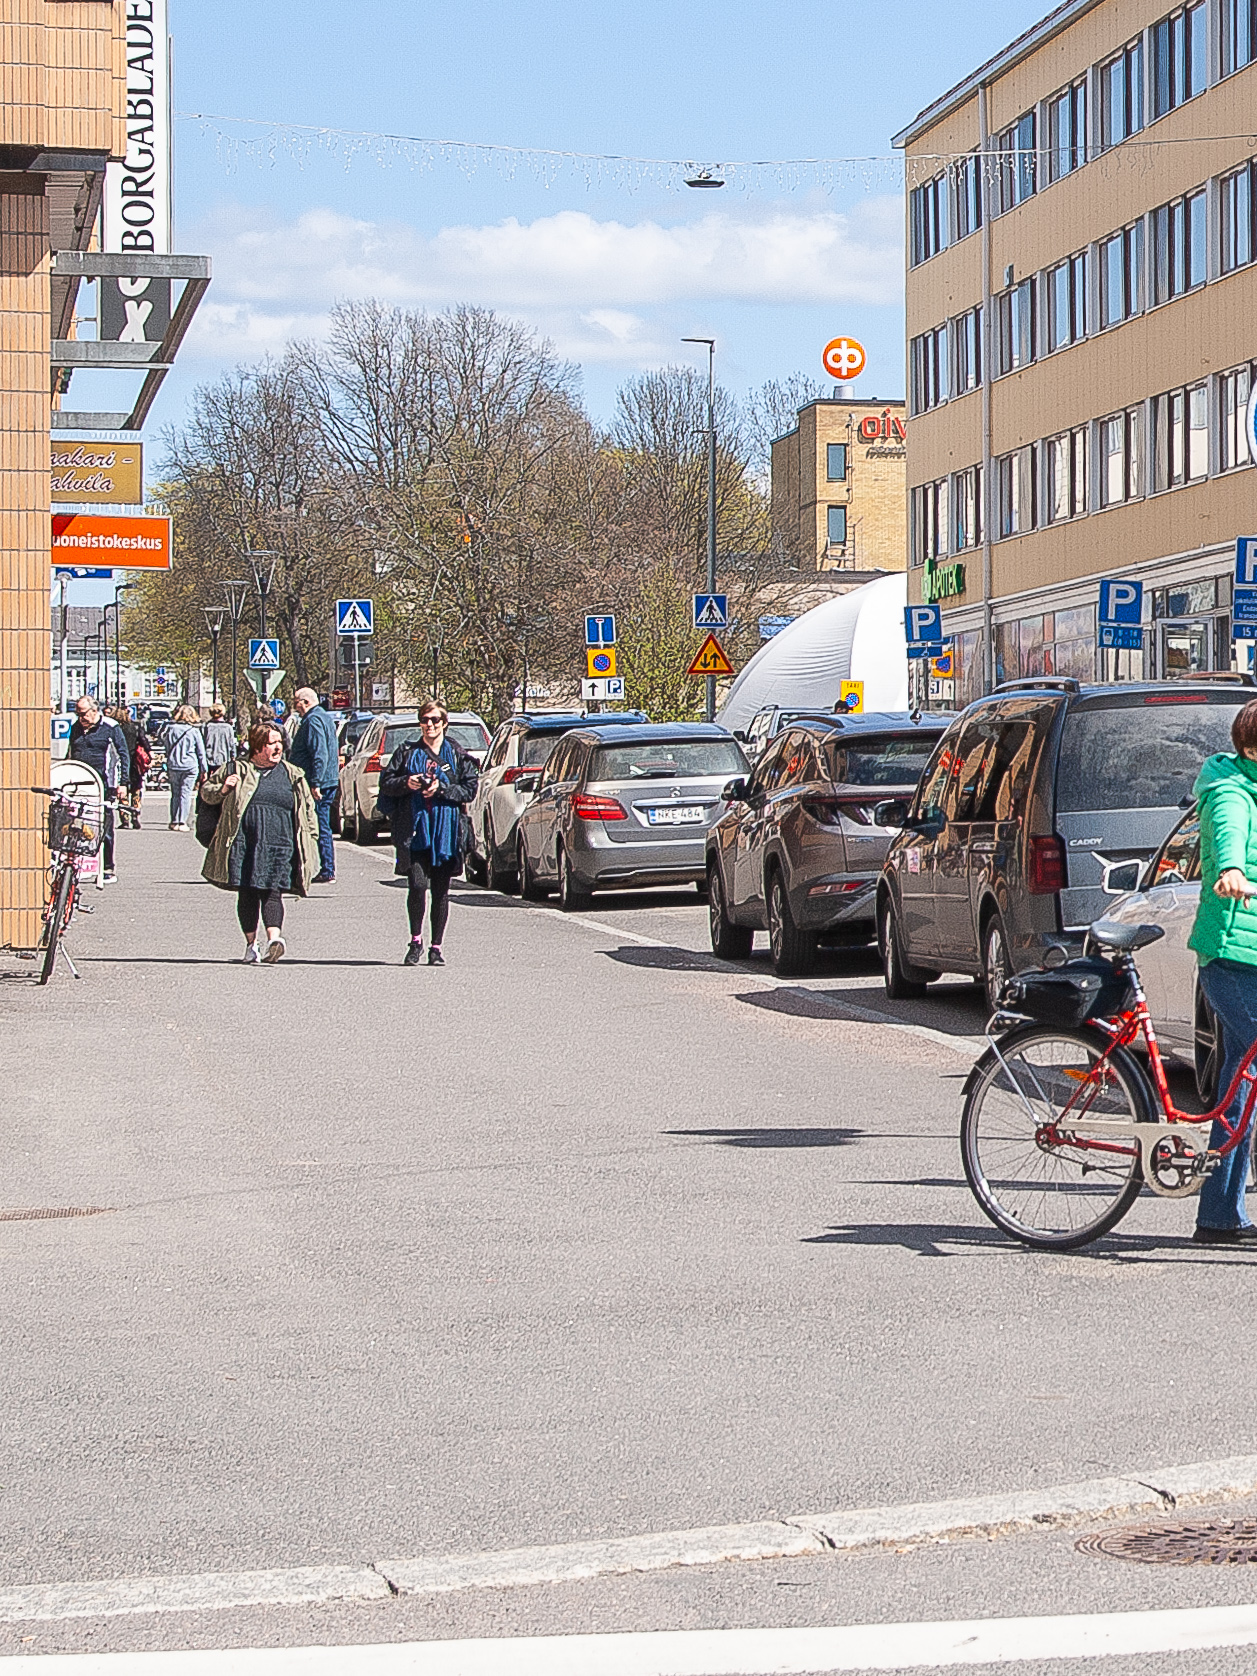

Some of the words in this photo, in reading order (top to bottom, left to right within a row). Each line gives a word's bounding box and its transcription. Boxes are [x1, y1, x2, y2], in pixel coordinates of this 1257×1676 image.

[931, 564, 960, 600] APOTEK
[1108, 583, 1137, 620] P
[911, 608, 936, 640] P
[1242, 626, 1252, 637] 15
[54, 724, 70, 739] P
[1069, 837, 1103, 846] CADDY
